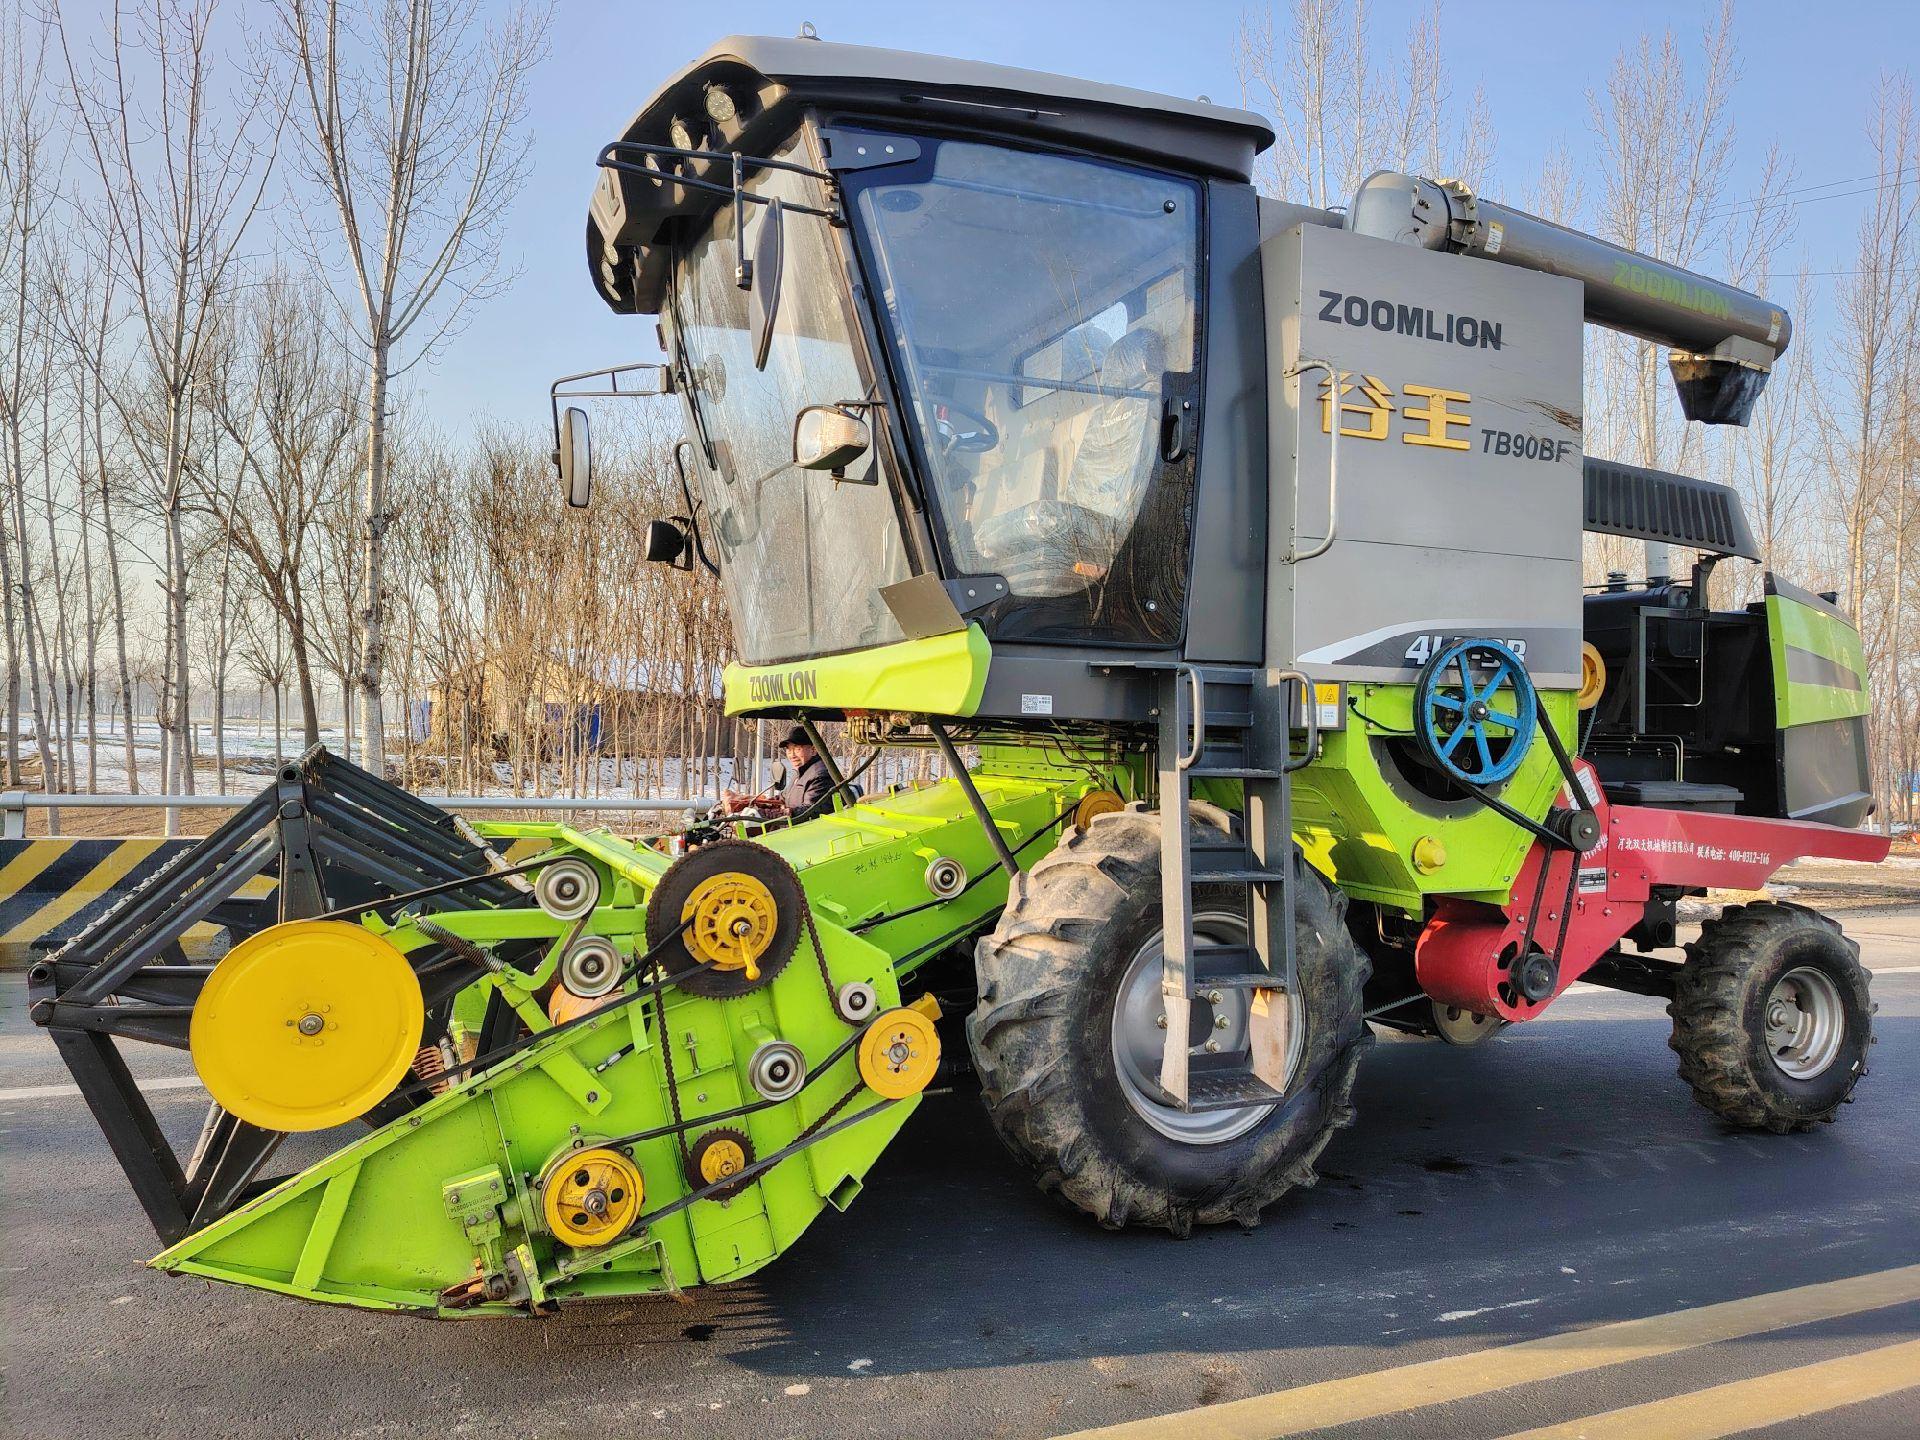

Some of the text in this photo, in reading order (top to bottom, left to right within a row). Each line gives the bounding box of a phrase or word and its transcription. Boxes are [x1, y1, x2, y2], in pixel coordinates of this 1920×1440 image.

[1318, 289, 1502, 351] ZOOMLION
[1611, 259, 1730, 320] ZOOMLION
[1317, 371, 1472, 451] 谷王
[1481, 428, 1573, 463] TB90BF
[749, 669, 817, 702] ZOOMLION
